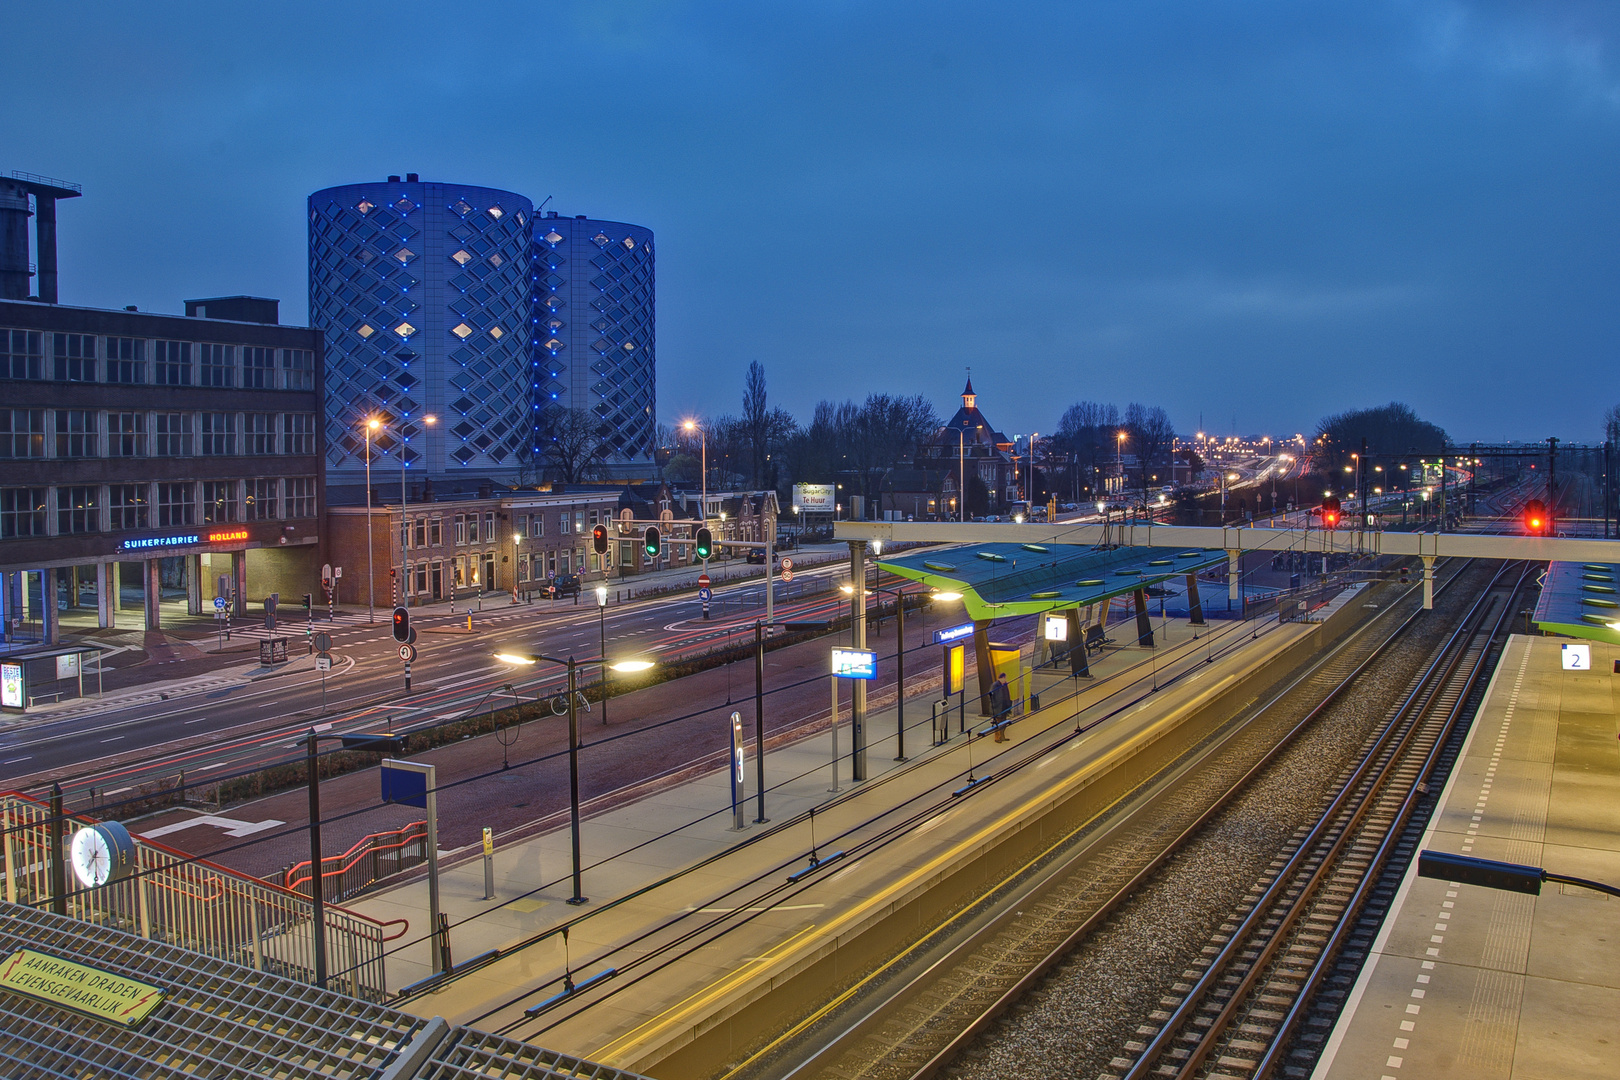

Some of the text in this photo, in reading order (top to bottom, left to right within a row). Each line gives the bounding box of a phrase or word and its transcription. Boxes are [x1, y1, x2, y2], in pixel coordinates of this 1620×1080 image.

[803, 496, 826, 504] Te Huur
[124, 531, 248, 549] SUIKERFABRIEK HOLLAND
[1053, 626, 1059, 638] 1
[1571, 653, 1581, 667] 2
[23, 957, 143, 1000] AANRAKEN DRADEN
[9, 971, 124, 1014] LEVENSGEVAARLIJK
